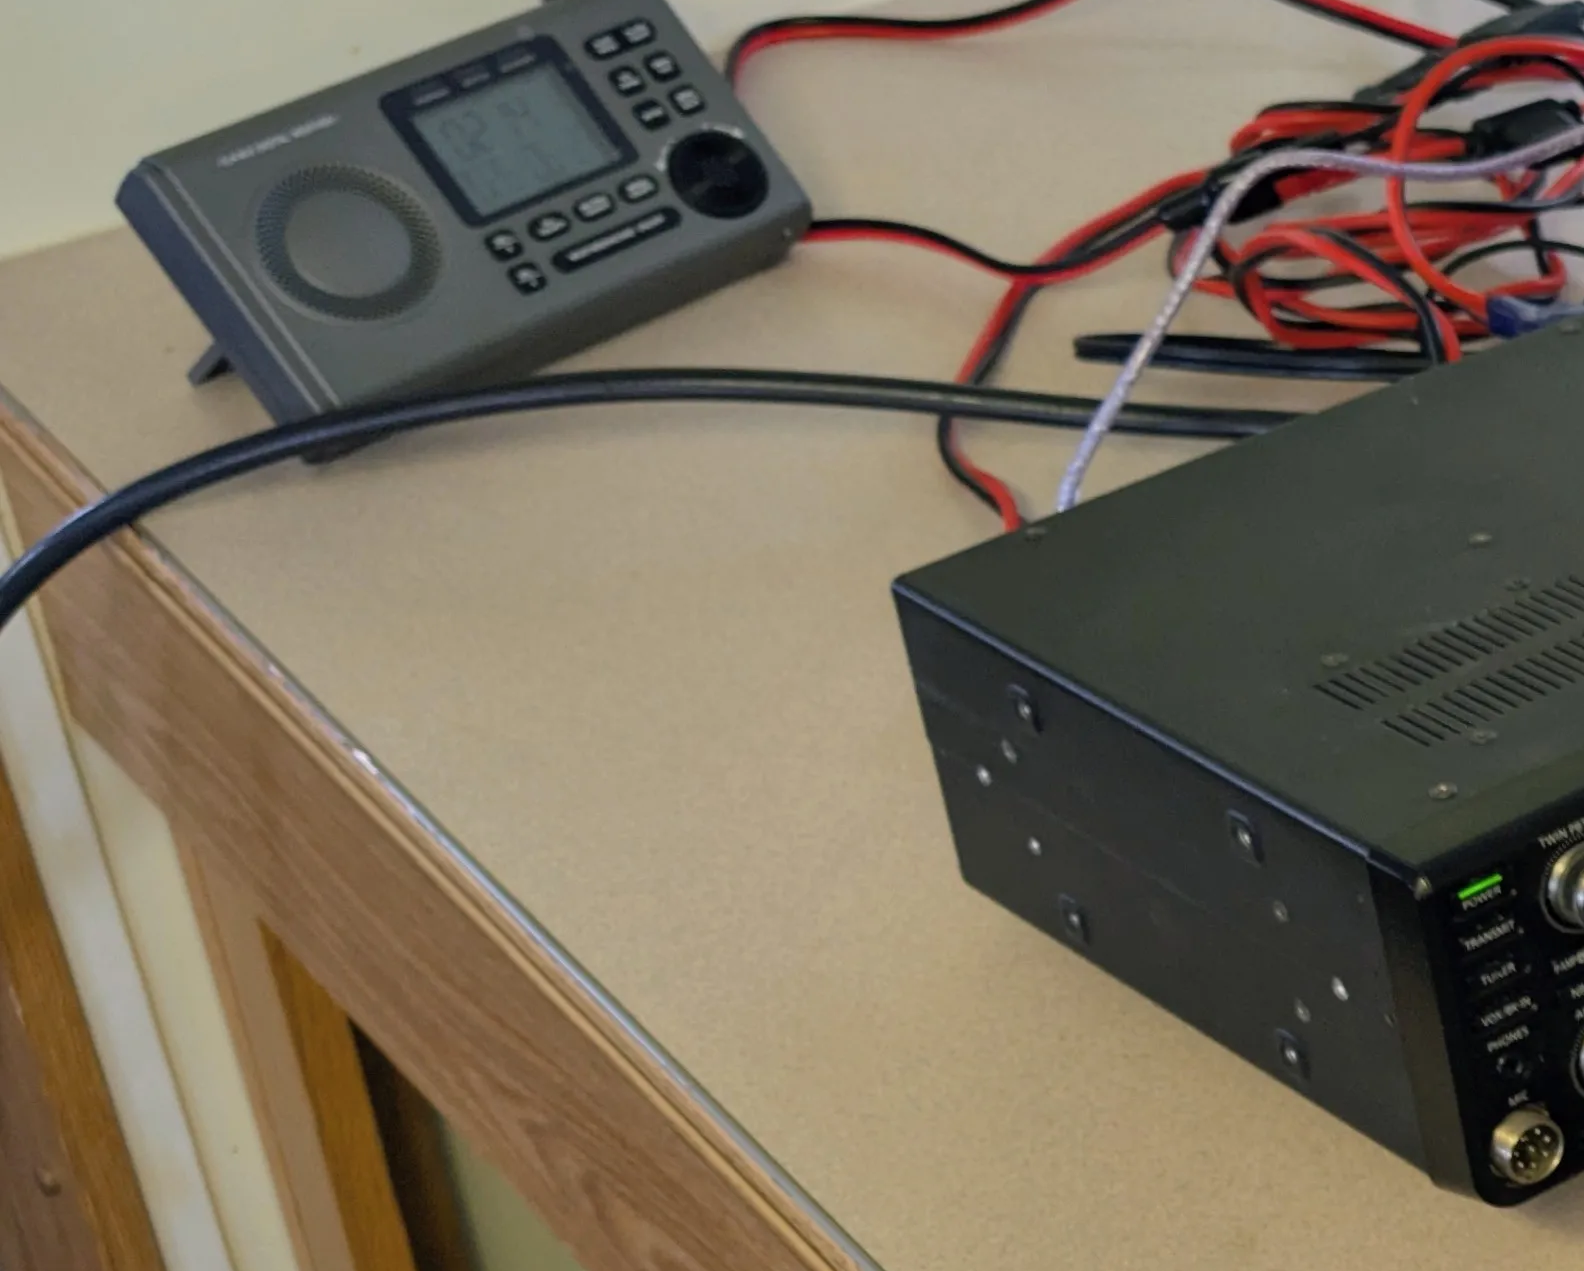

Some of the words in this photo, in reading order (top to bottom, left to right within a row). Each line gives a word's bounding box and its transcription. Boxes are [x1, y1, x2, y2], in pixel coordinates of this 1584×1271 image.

[1462, 885, 1502, 910] POWER
[1463, 919, 1515, 952] TRANSMIT
[1480, 961, 1517, 987] TUNER
[1486, 1026, 1530, 1053] PHONES
